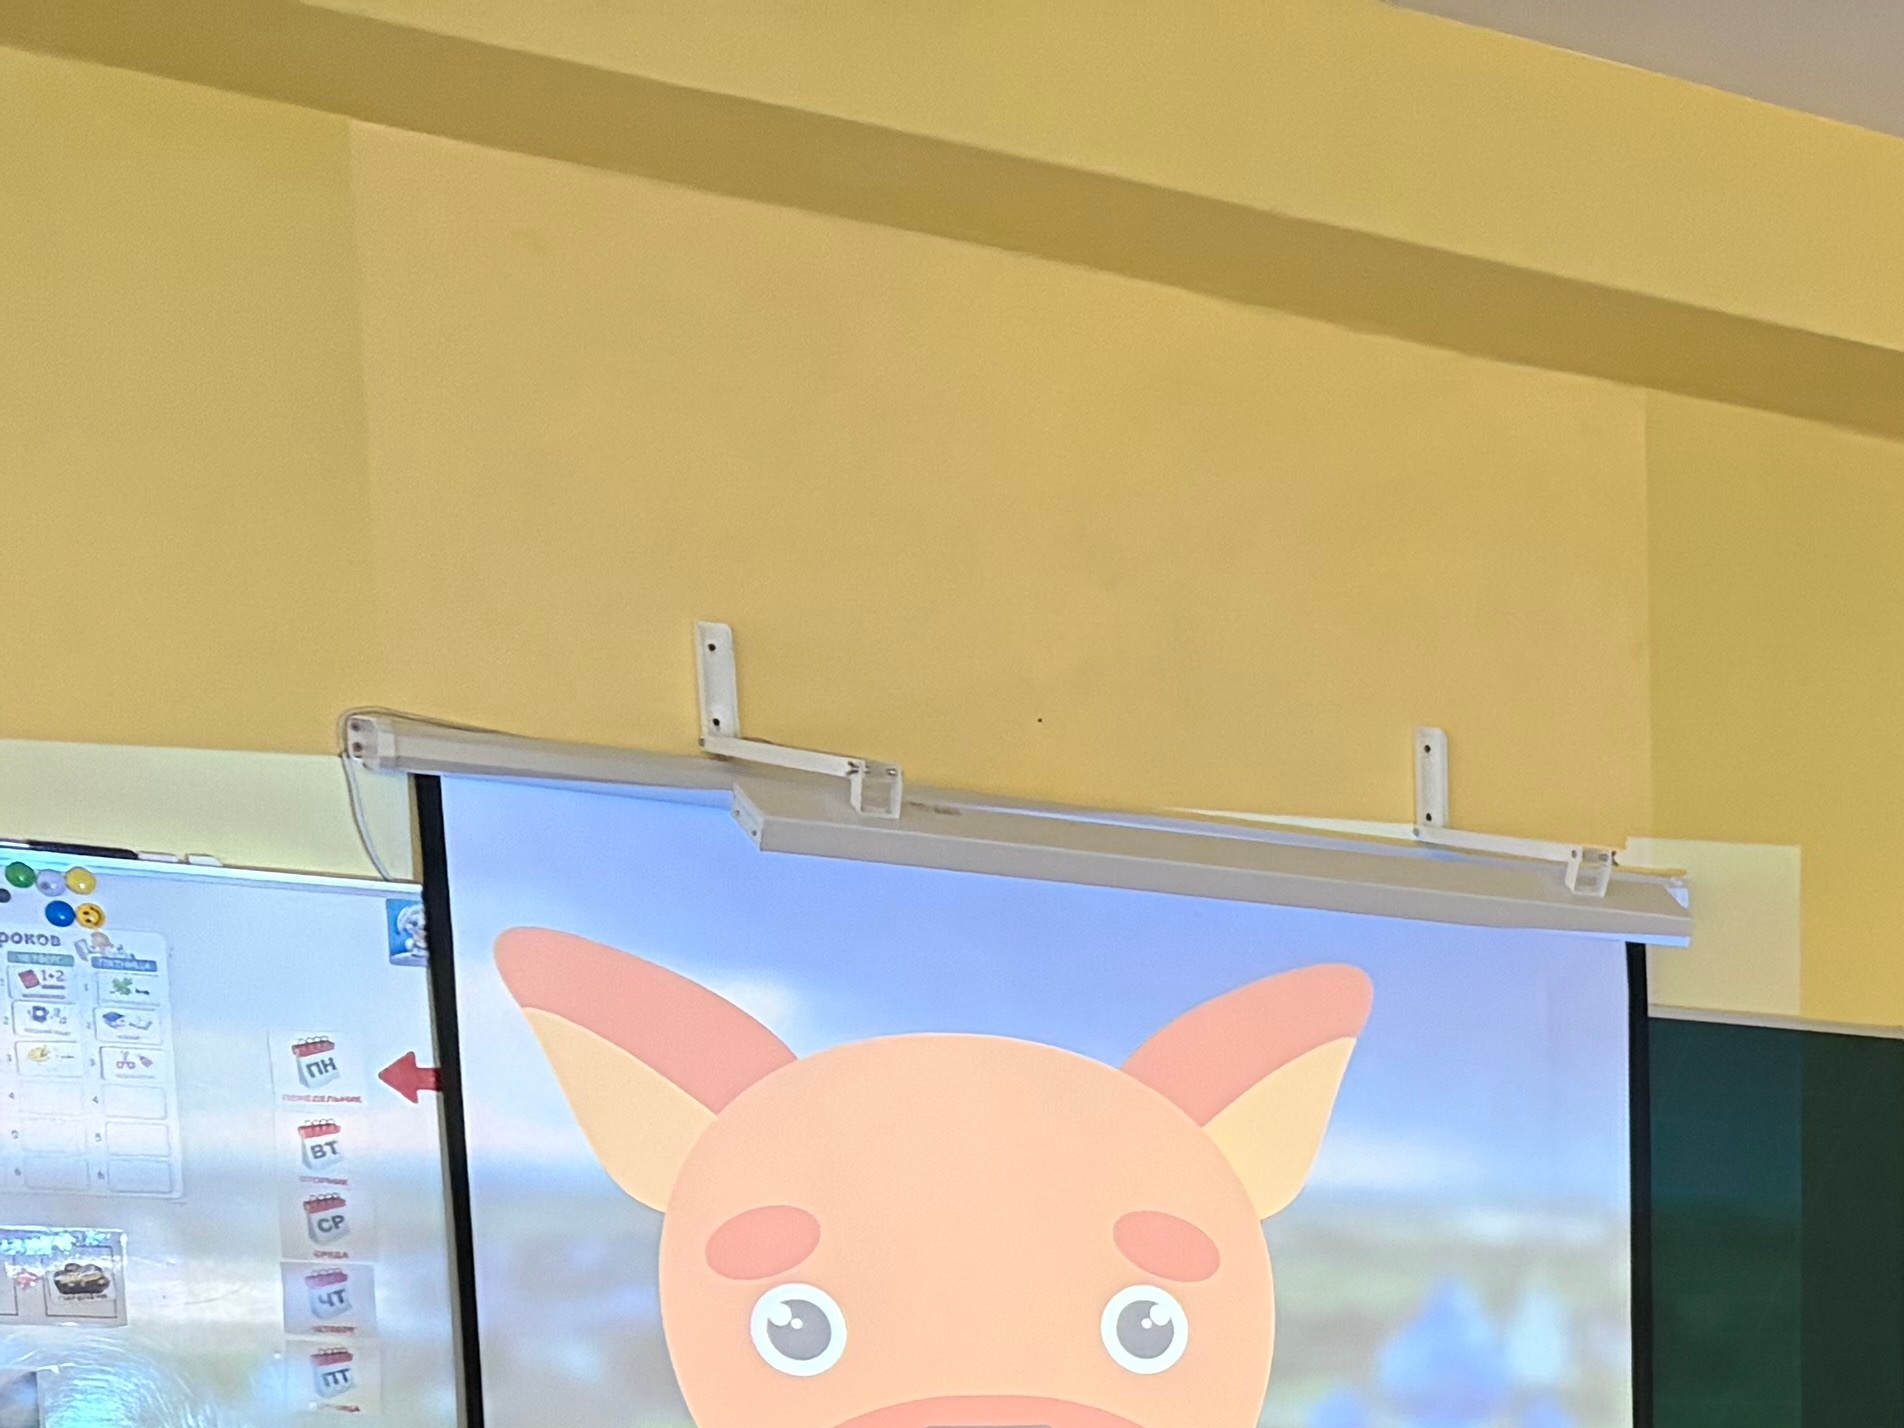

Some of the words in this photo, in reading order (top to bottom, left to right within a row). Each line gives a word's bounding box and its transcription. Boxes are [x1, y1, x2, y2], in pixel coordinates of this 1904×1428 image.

[306, 1057, 337, 1078] ПН
[310, 1140, 339, 1160] ВТ
[317, 1215, 345, 1233] СР
[319, 1289, 346, 1307] ЧТ
[321, 1368, 350, 1387] ПТ
